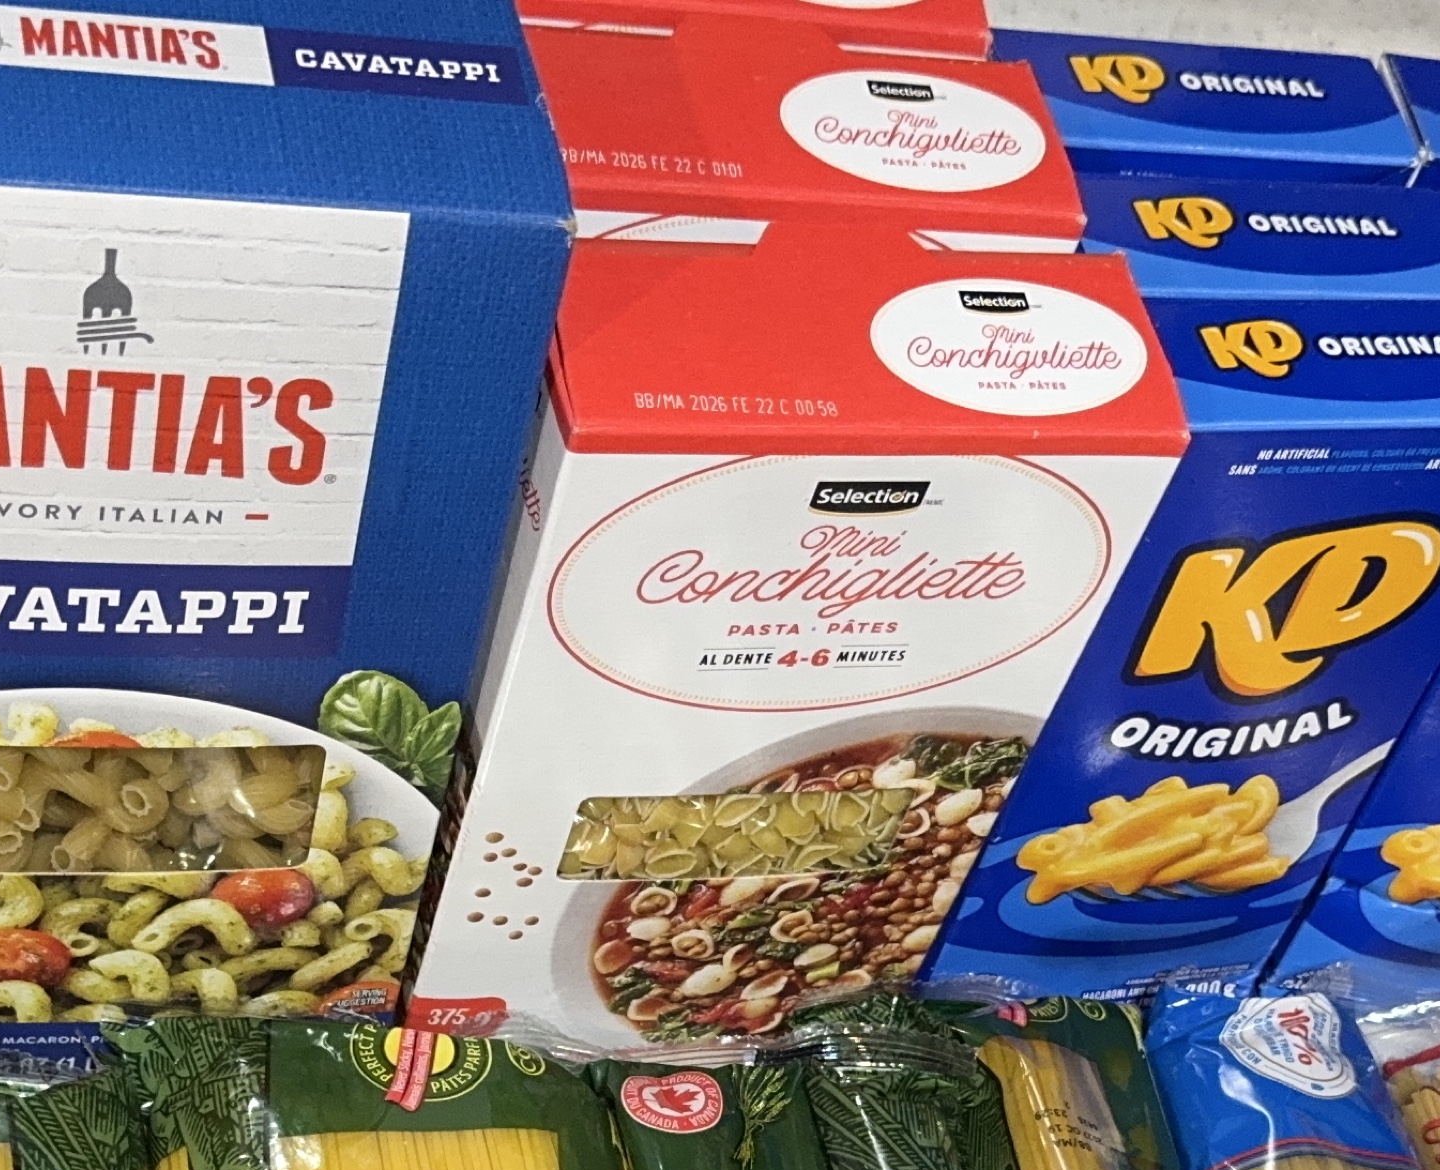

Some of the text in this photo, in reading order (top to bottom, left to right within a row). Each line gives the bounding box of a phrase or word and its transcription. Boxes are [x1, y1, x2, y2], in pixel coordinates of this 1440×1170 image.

[20, 17, 502, 84] MANTIA'S CAVATAPPI
[1070, 55, 1325, 104] KD ORIGINAL
[872, 84, 931, 98] Selection
[888, 110, 937, 129] Mini
[1134, 195, 1398, 246] KD ORIGINAL
[963, 295, 1026, 308] Selection
[982, 324, 1035, 344] Mini
[1201, 319, 1303, 377] KD
[690, 395, 774, 415] 2026 22
[1273, 449, 1330, 460] ARTIFICIAL
[1228, 465, 1257, 475] SANS
[816, 488, 920, 504] Selection
[100, 506, 224, 525] ITALIAN
[800, 525, 908, 558] Mini
[636, 549, 1026, 619] Conchigliette
[728, 619, 899, 636] PASTA PÂTES
[699, 649, 906, 667] AL DENTE 4-6 MINUTES
[1112, 702, 1353, 758] ORIGINAL
[351, 988, 387, 997] SERVING
[428, 1008, 466, 1025] 375
[358, 1030, 394, 1083] PERFECT
